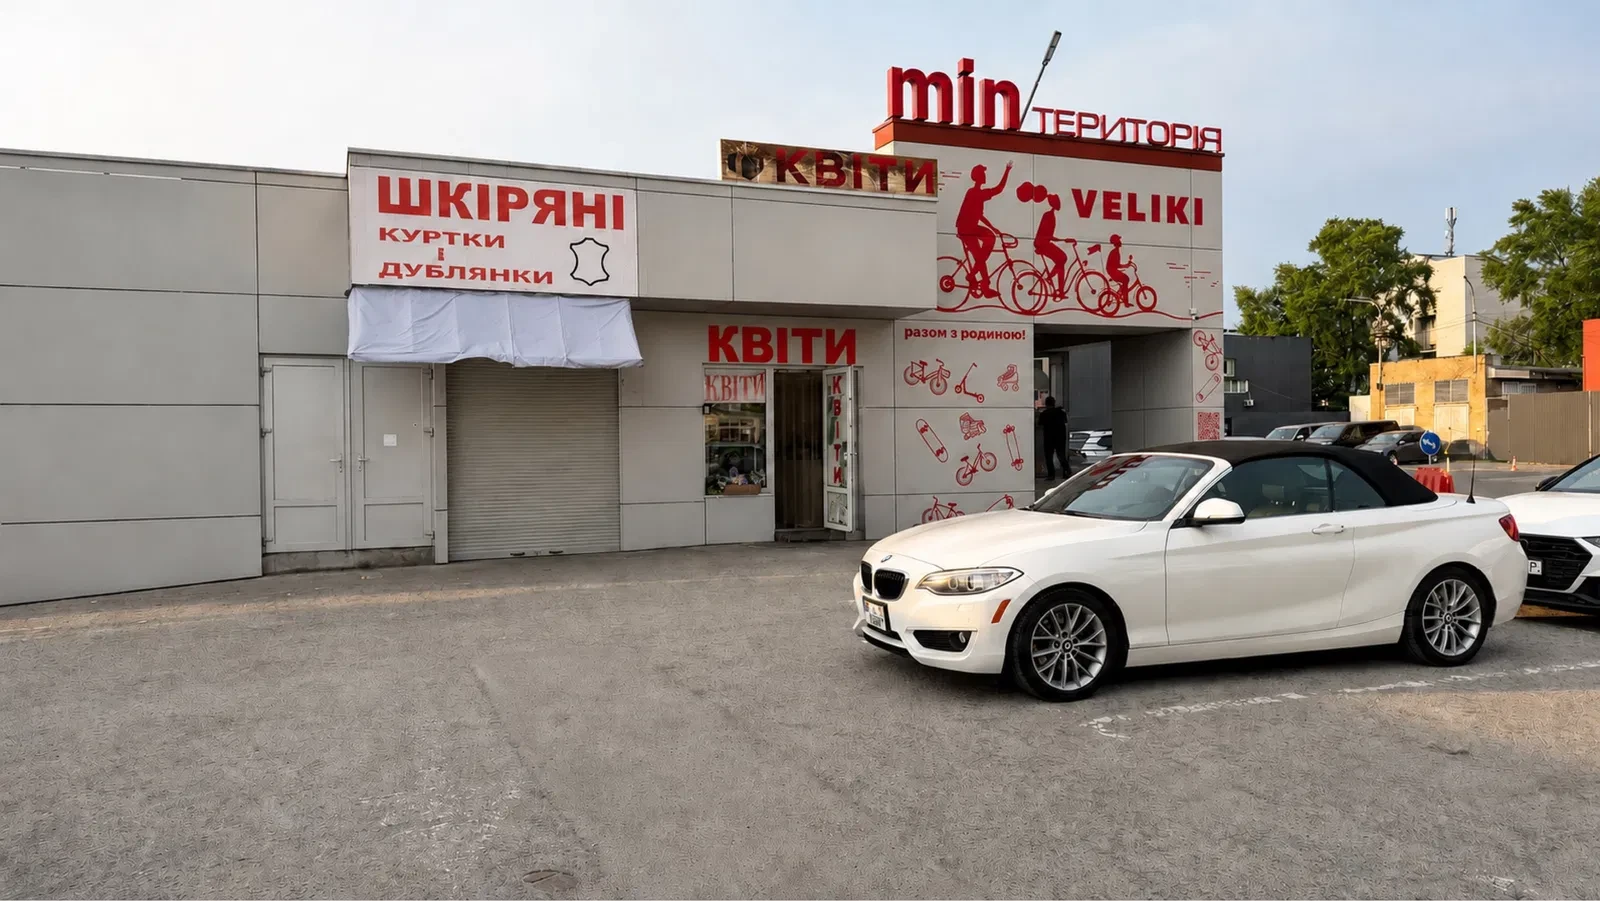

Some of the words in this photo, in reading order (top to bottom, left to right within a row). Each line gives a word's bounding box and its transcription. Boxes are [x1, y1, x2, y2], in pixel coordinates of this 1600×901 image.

[887, 57, 1021, 131] min
[1032, 106, 1222, 152] ТЕРИТОРІЯ
[775, 147, 936, 195] КВІТИ
[377, 176, 625, 231] ШКІРЯНІ
[1071, 188, 1204, 226] VELIKI
[378, 227, 506, 249] КУРТКИ
[378, 262, 554, 285] ДУБЛЯНКИ
[708, 325, 857, 364] КВІТИ
[904, 328, 947, 340] разом
[960, 329, 1026, 340] родиною!
[705, 372, 765, 401] КВІТИ
[832, 375, 842, 484] КВІТИ
